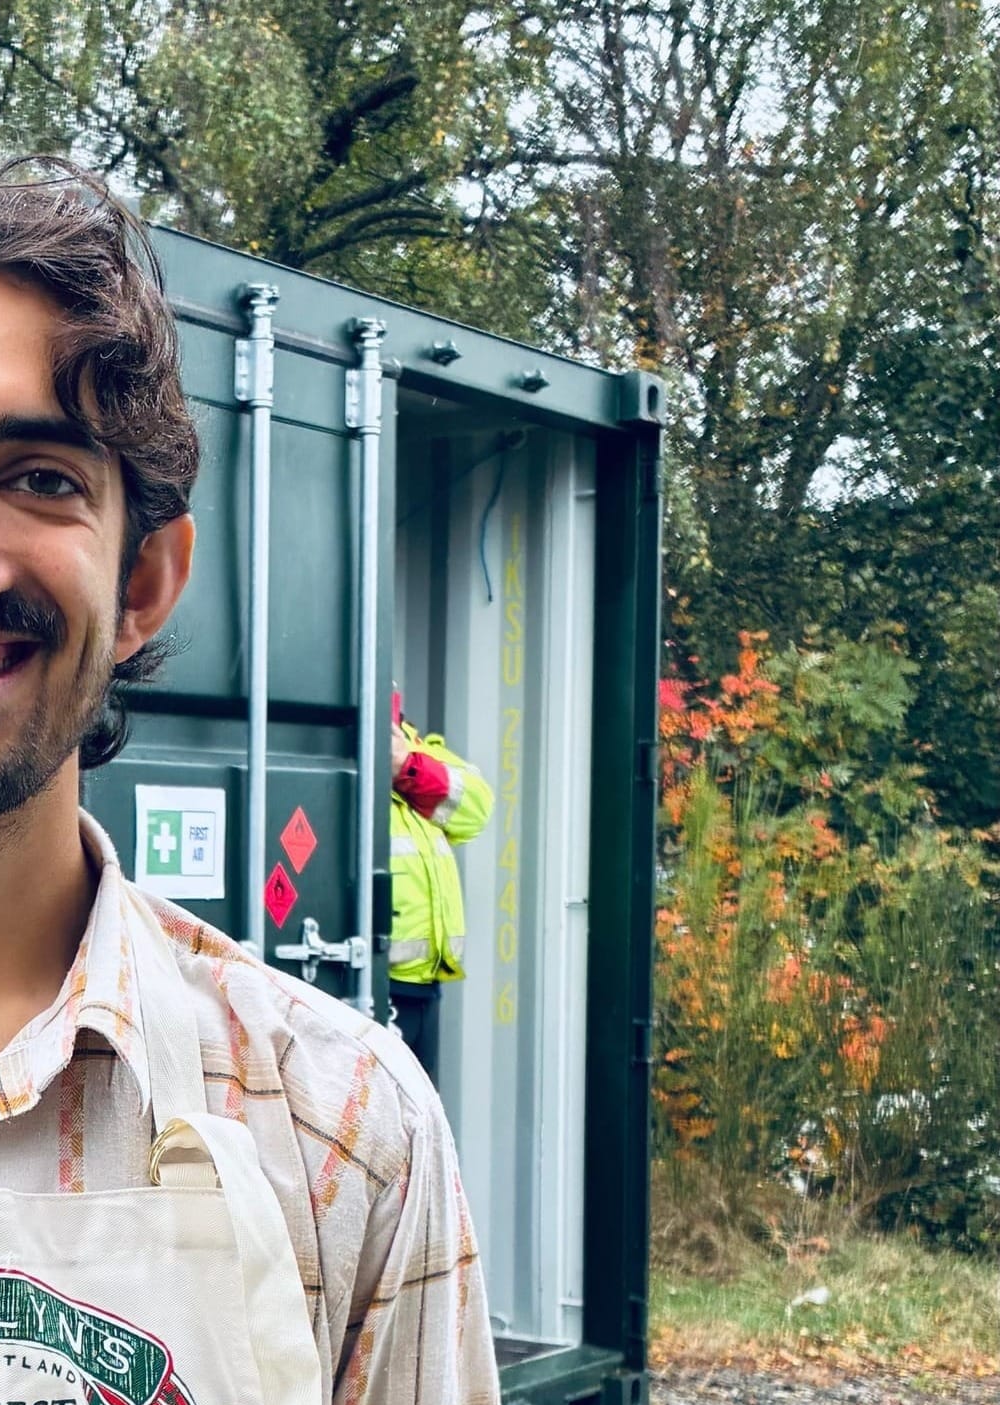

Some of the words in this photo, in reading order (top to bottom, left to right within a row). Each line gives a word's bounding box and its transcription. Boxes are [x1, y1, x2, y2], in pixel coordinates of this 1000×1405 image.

[188, 826, 209, 841] FIRST
[498, 708, 521, 962] 257440
[192, 847, 204, 861] AID
[496, 981, 516, 1025] 6
